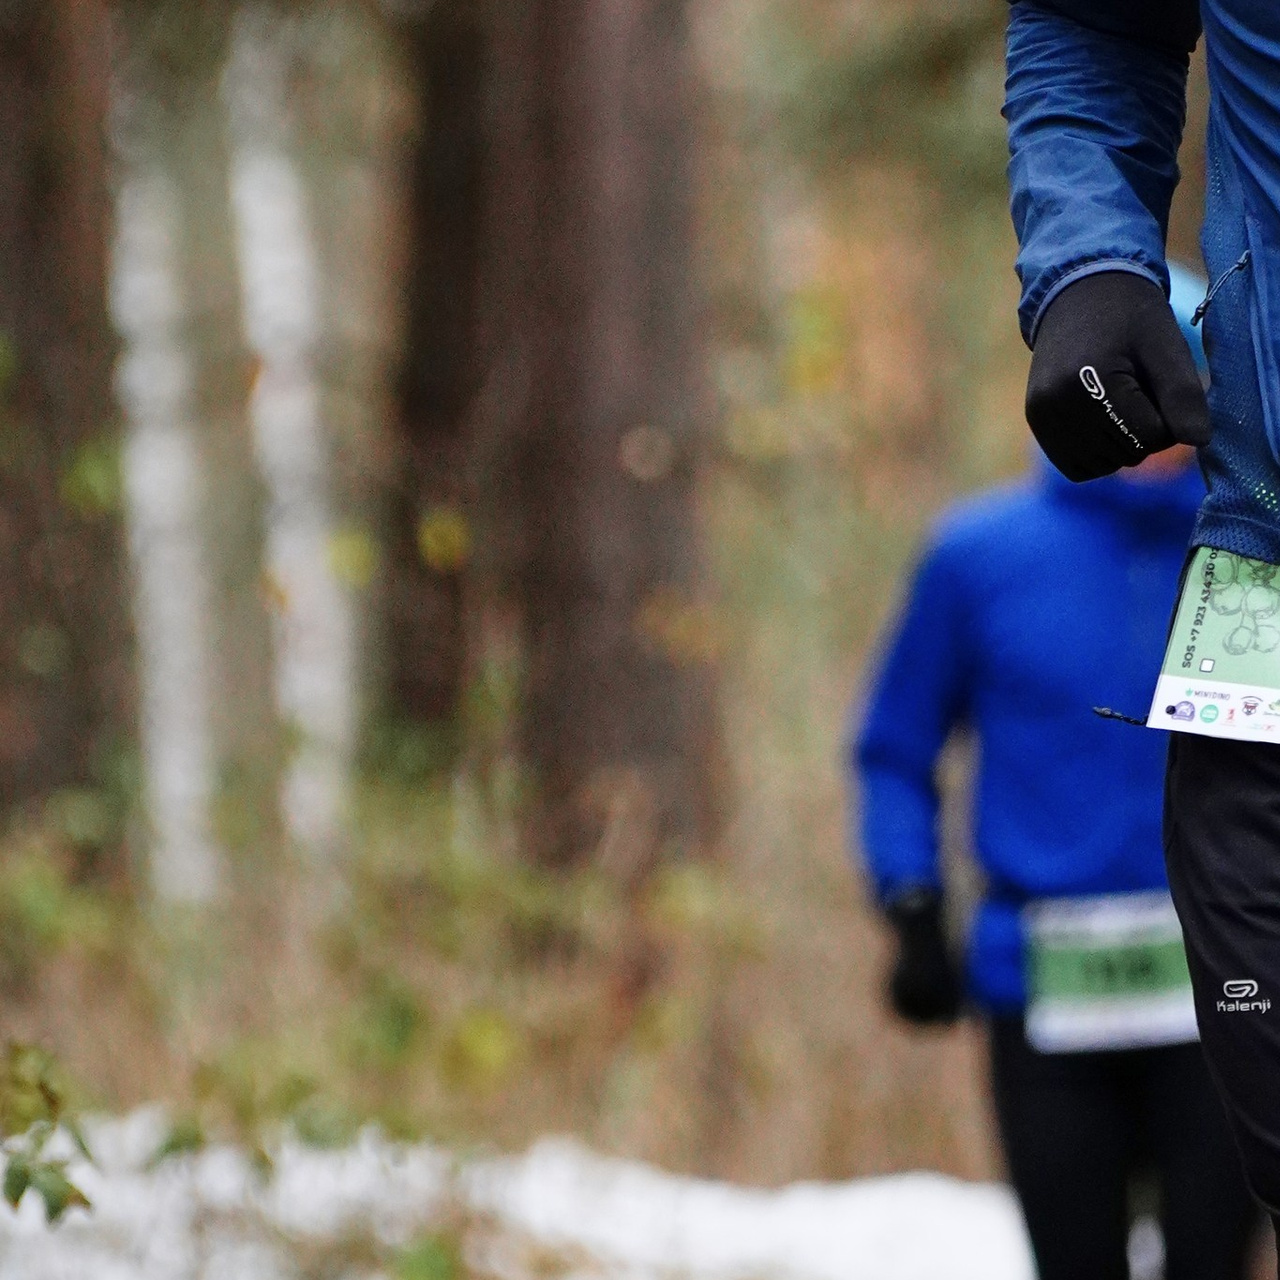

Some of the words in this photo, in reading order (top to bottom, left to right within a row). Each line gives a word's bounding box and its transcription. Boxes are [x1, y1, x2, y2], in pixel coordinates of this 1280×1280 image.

[1205, 562, 1216, 579] 30
[1193, 605, 1207, 626] 923
[1190, 628, 1200, 642] +7
[1182, 644, 1196, 669] SOS
[1194, 690, 1231, 701] MINIDINO
[1216, 998, 1272, 1014] Kalenji
